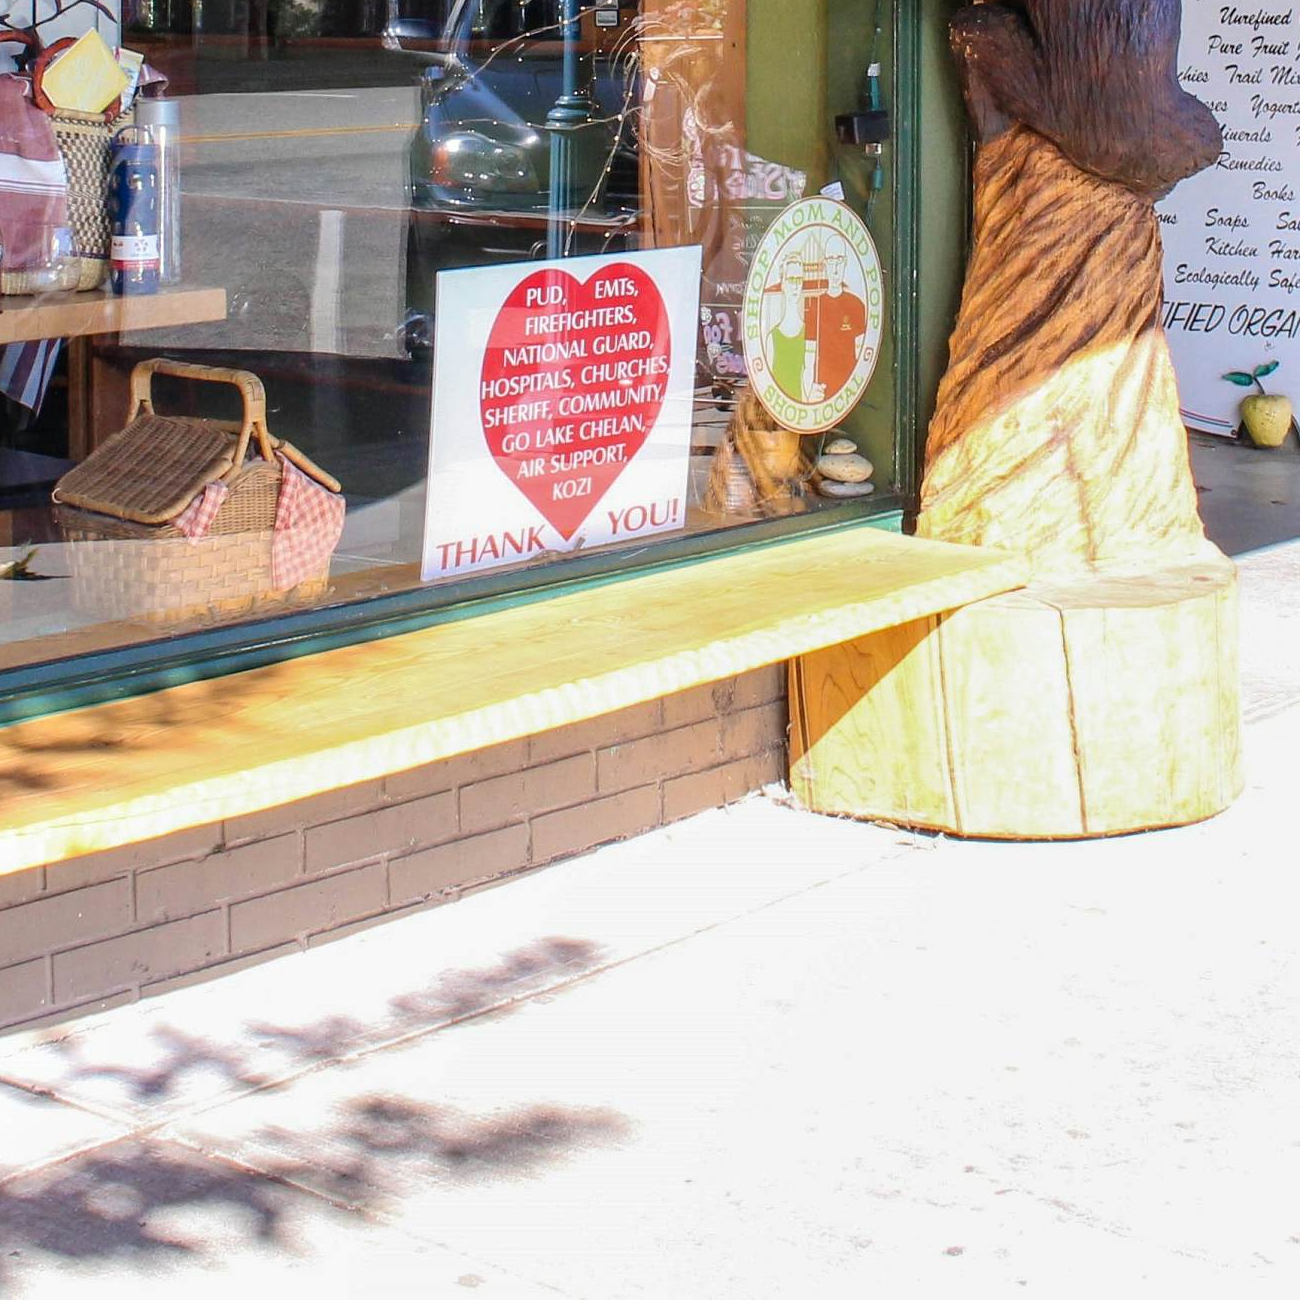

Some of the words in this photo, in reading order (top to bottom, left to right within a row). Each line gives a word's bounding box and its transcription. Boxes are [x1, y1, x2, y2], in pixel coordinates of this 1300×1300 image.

[1219, 5, 1293, 32] Unrefined
[1207, 34, 1243, 56] Pure
[1250, 35, 1290, 59] Fruit
[1178, 66, 1209, 83] hies
[1224, 63, 1263, 85] Trail
[1215, 152, 1283, 172] Remedies
[1251, 180, 1295, 202] Books
[1204, 207, 1250, 233] Soaps
[1204, 236, 1259, 258] Kitchen
[748, 250, 770, 340] SHOP
[774, 204, 826, 242] MOM
[832, 209, 869, 258] AND
[867, 266, 880, 331] POP
[1174, 263, 1260, 292] Ecologically
[527, 285, 567, 307] PUD,
[595, 278, 639, 299] EMTs,
[525, 305, 637, 336] FIREFIGHTERS,
[1163, 301, 1225, 333] IFIED
[503, 339, 588, 367] NATIONAL
[592, 330, 654, 355] GUARD,
[481, 369, 575, 400] HOSPITALS,
[581, 355, 671, 385] CHURCHES,
[484, 400, 553, 428] SHERIFF,
[559, 384, 665, 416] COMMUNITY,
[763, 385, 808, 426] SHOP
[813, 375, 864, 426] LOCAL
[502, 432, 530, 453] GO
[536, 425, 574, 448] LAKE
[579, 414, 646, 440] CHELAN,
[517, 458, 545, 479] AIR
[550, 443, 628, 473] SUPPORT,
[552, 477, 592, 501] KOZI
[436, 525, 546, 570] THANK
[608, 498, 679, 535] YOU!
